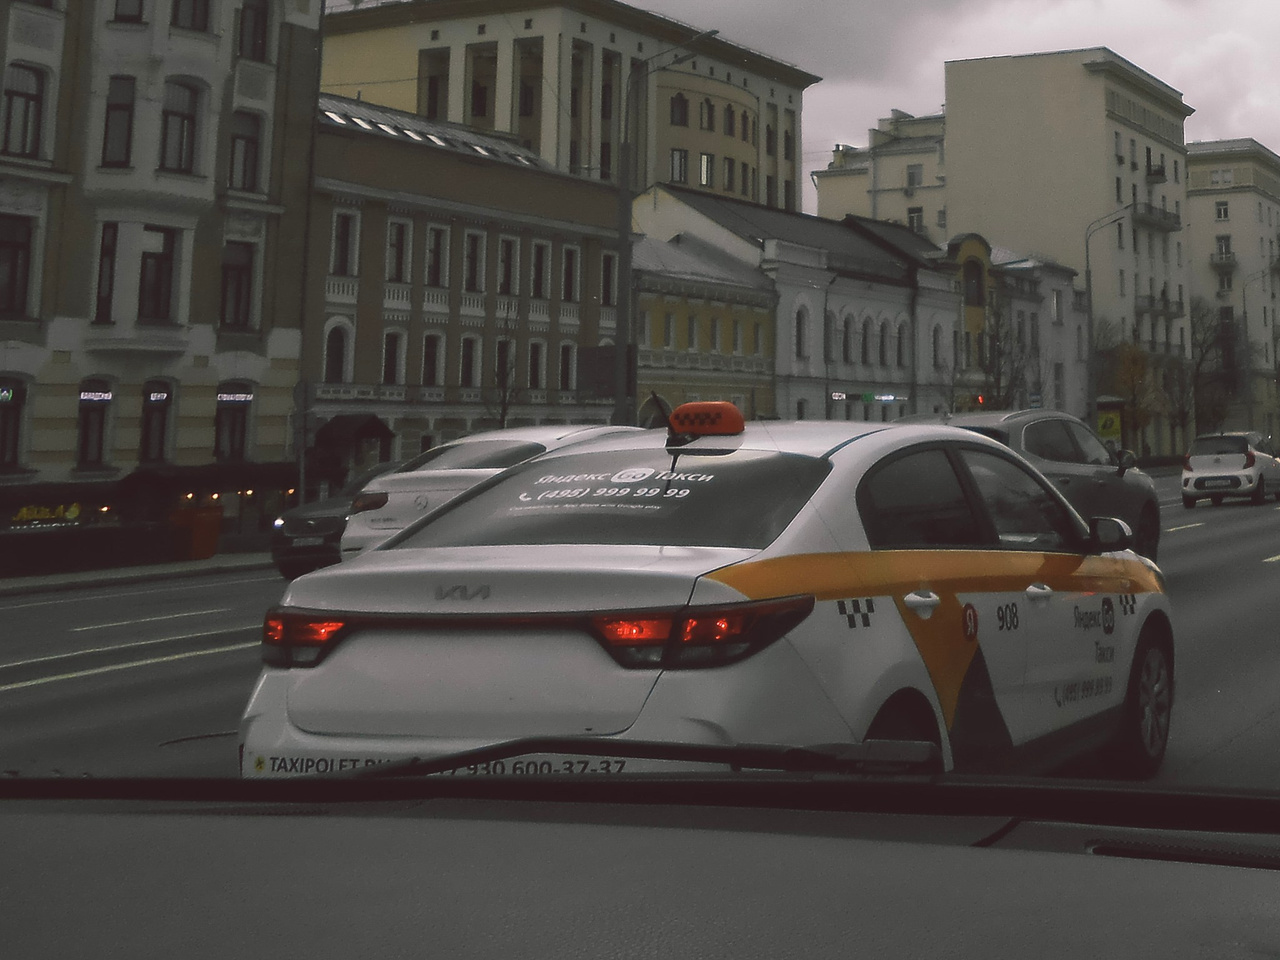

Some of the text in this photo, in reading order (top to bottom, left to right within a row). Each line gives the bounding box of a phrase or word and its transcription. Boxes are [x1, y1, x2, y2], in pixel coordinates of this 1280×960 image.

[534, 473, 611, 485] Яндекс
[537, 487, 691, 501] (495) 999 99 99
[965, 609, 975, 636] Я
[996, 602, 1019, 631] 908
[1074, 605, 1102, 632] Яндекс
